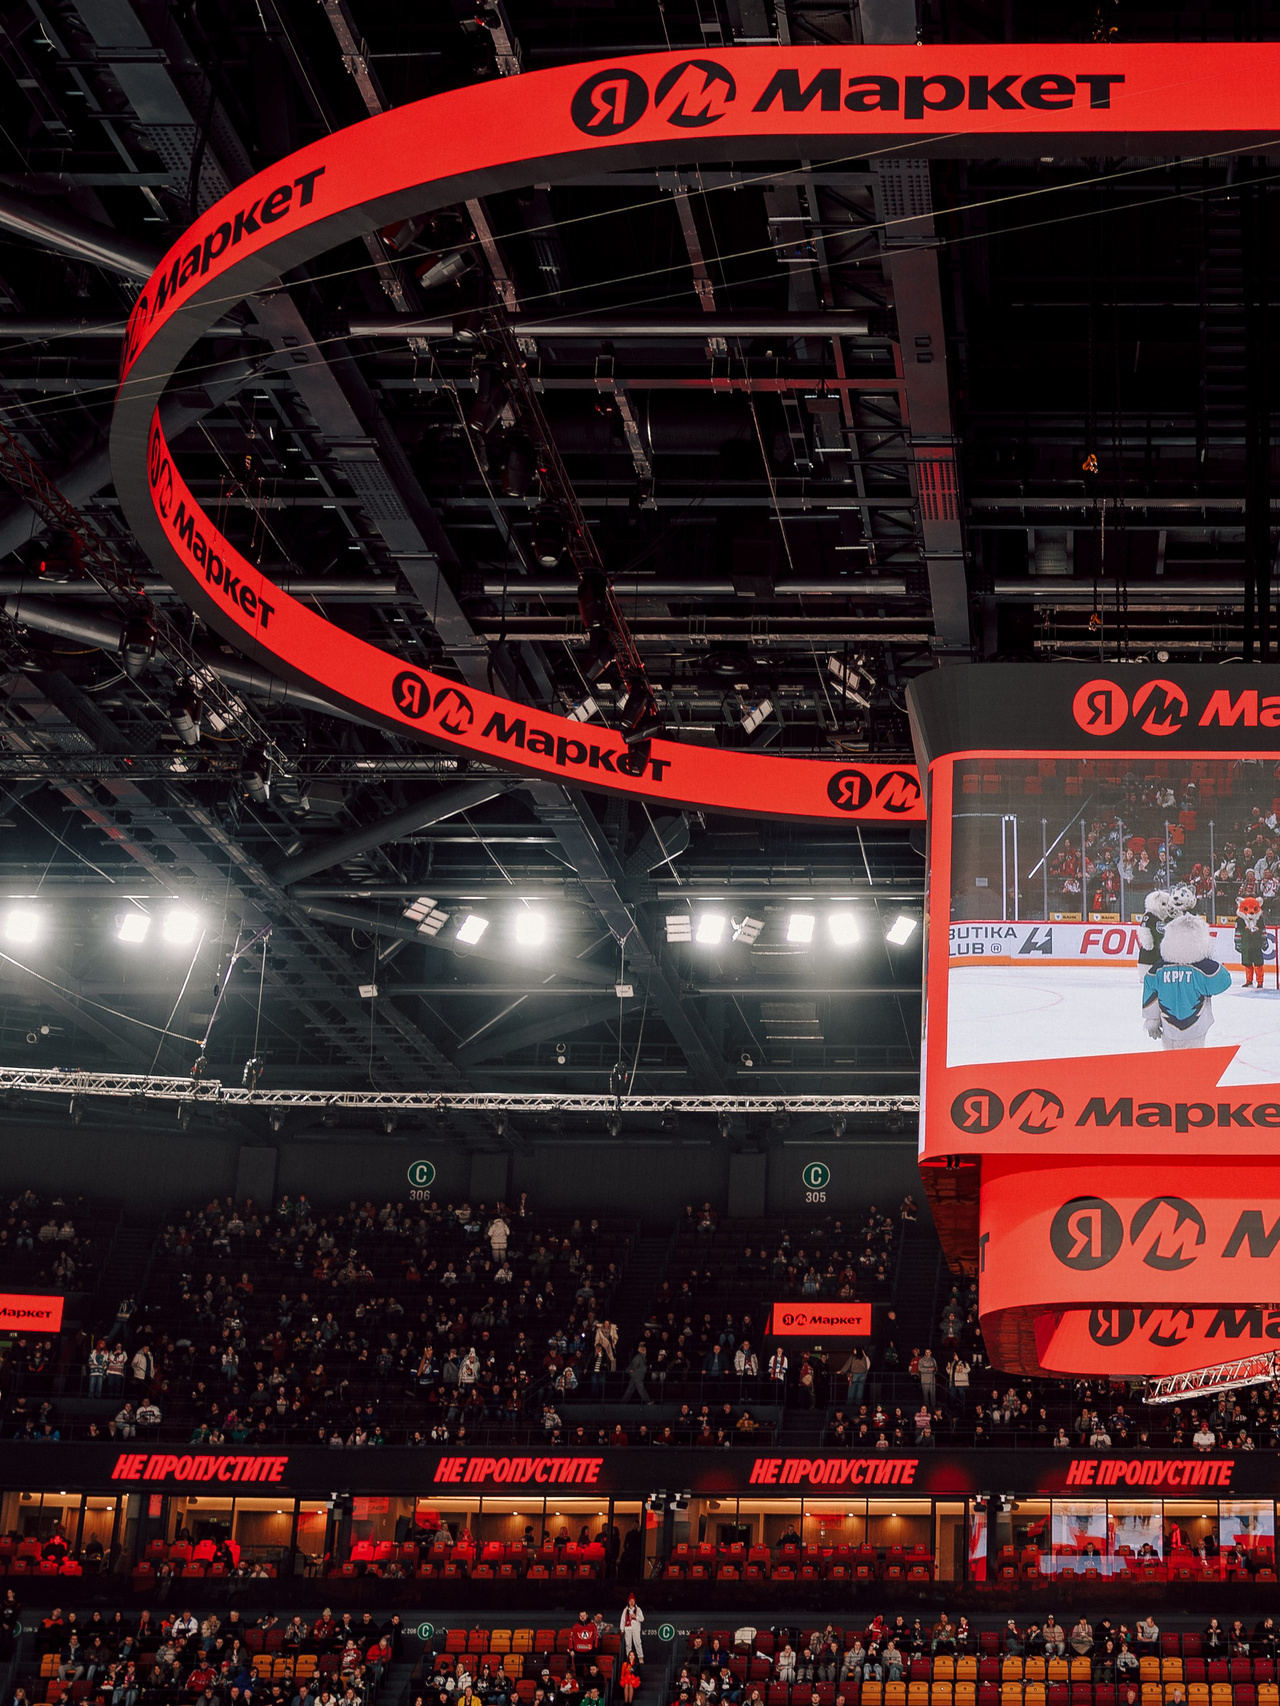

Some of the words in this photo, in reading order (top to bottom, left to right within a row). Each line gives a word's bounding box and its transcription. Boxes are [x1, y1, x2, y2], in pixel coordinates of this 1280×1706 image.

[752, 68, 1126, 120] Маркет
[150, 165, 326, 325] Маркет
[172, 501, 275, 629] Маркет
[1163, 970, 1193, 984] КРУТ
[410, 1190, 431, 1201] 306
[805, 1191, 826, 1203] 305
[809, 1315, 863, 1326] Маркет
[111, 1454, 148, 1480] НЕ
[143, 1455, 288, 1481] ПРОПУСТИТЕ
[434, 1457, 467, 1482] НЕ
[463, 1457, 603, 1483] ПРОПУСТИТЕ
[750, 1459, 782, 1484] НЕ
[779, 1459, 919, 1485] ПРОПУСТИТЕ
[1066, 1460, 1098, 1485] НЕ
[1095, 1460, 1235, 1486] ПРОПУСТИТЕ
